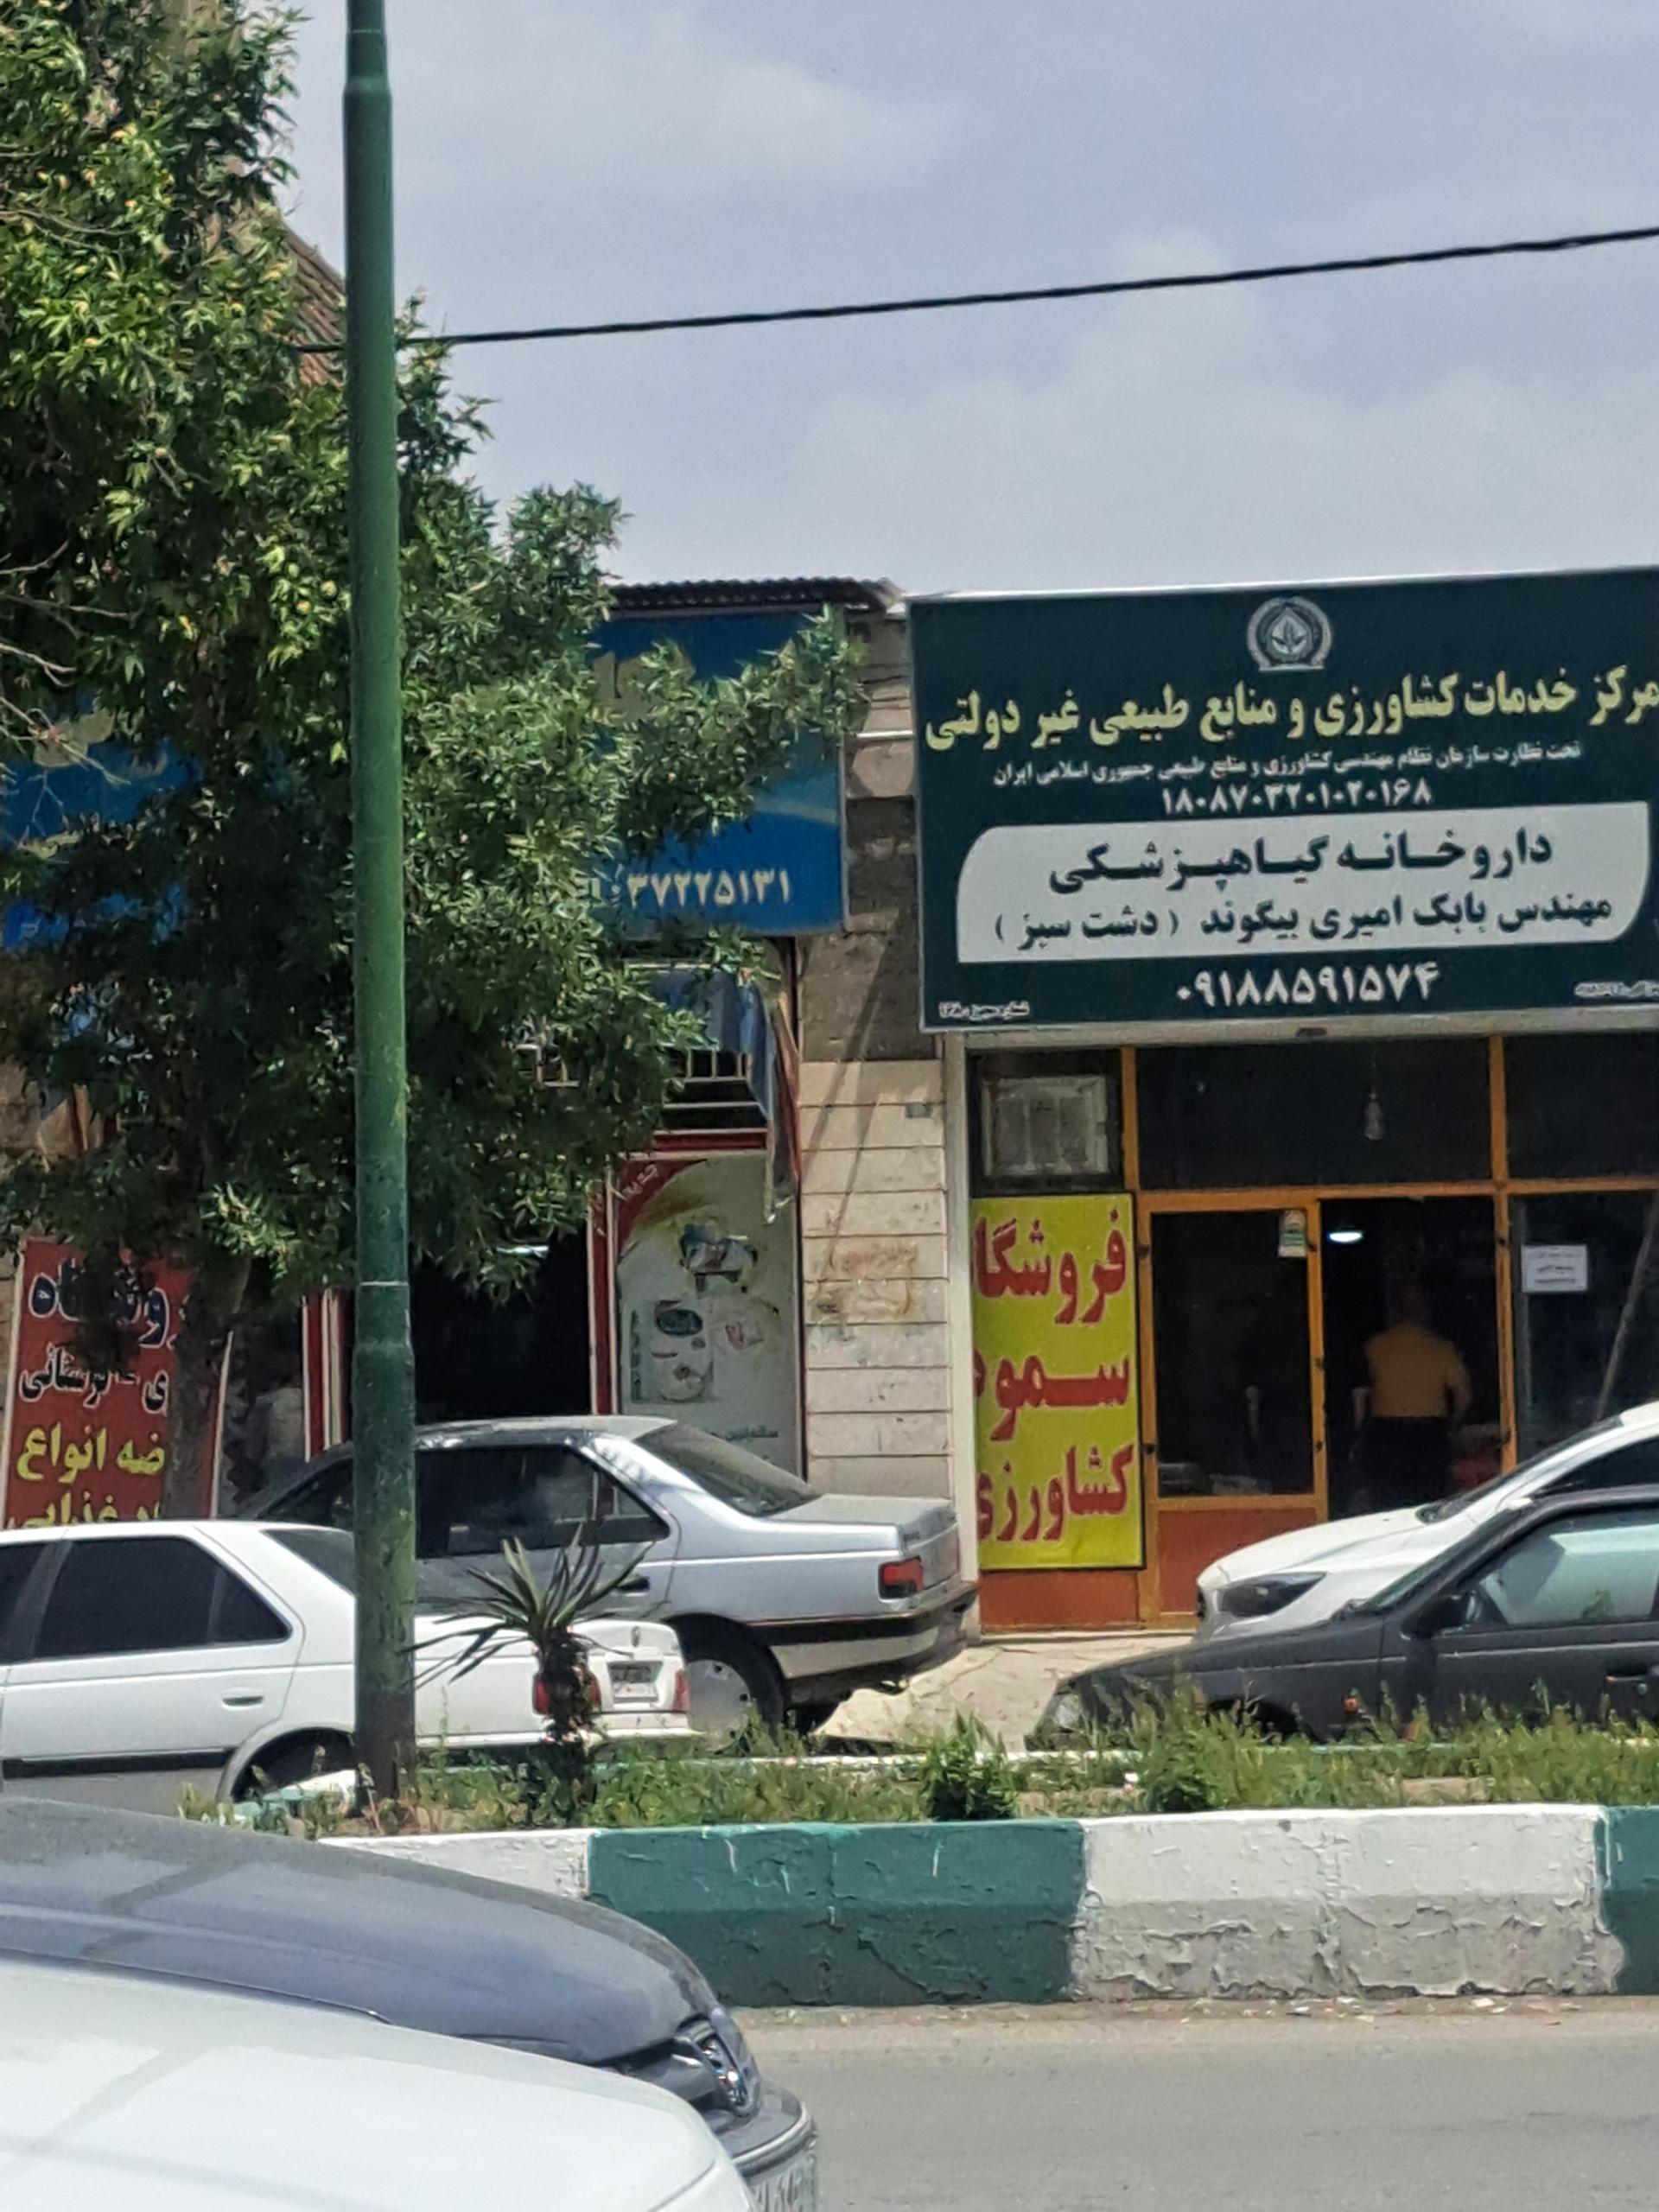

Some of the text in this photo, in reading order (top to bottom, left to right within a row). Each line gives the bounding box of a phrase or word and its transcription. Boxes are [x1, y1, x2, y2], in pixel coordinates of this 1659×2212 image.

[925, 664, 1659, 751] مرکز خدمات کشاورزی و منابع طبیعی غیر دولتی
[1049, 827, 1553, 893] داروخانه گیاهپزشکی
[1310, 894, 1402, 939] امیری
[1413, 891, 1486, 934] بابک
[1497, 893, 1613, 932] مهندس
[1176, 961, 1440, 1007] ۰۹۱۸۸۵۹۱۵۷۴
[975, 1205, 1128, 1325] فروشگا
[16, 1421, 107, 1484] انواع
[976, 1443, 1135, 1541] کشاورزی
